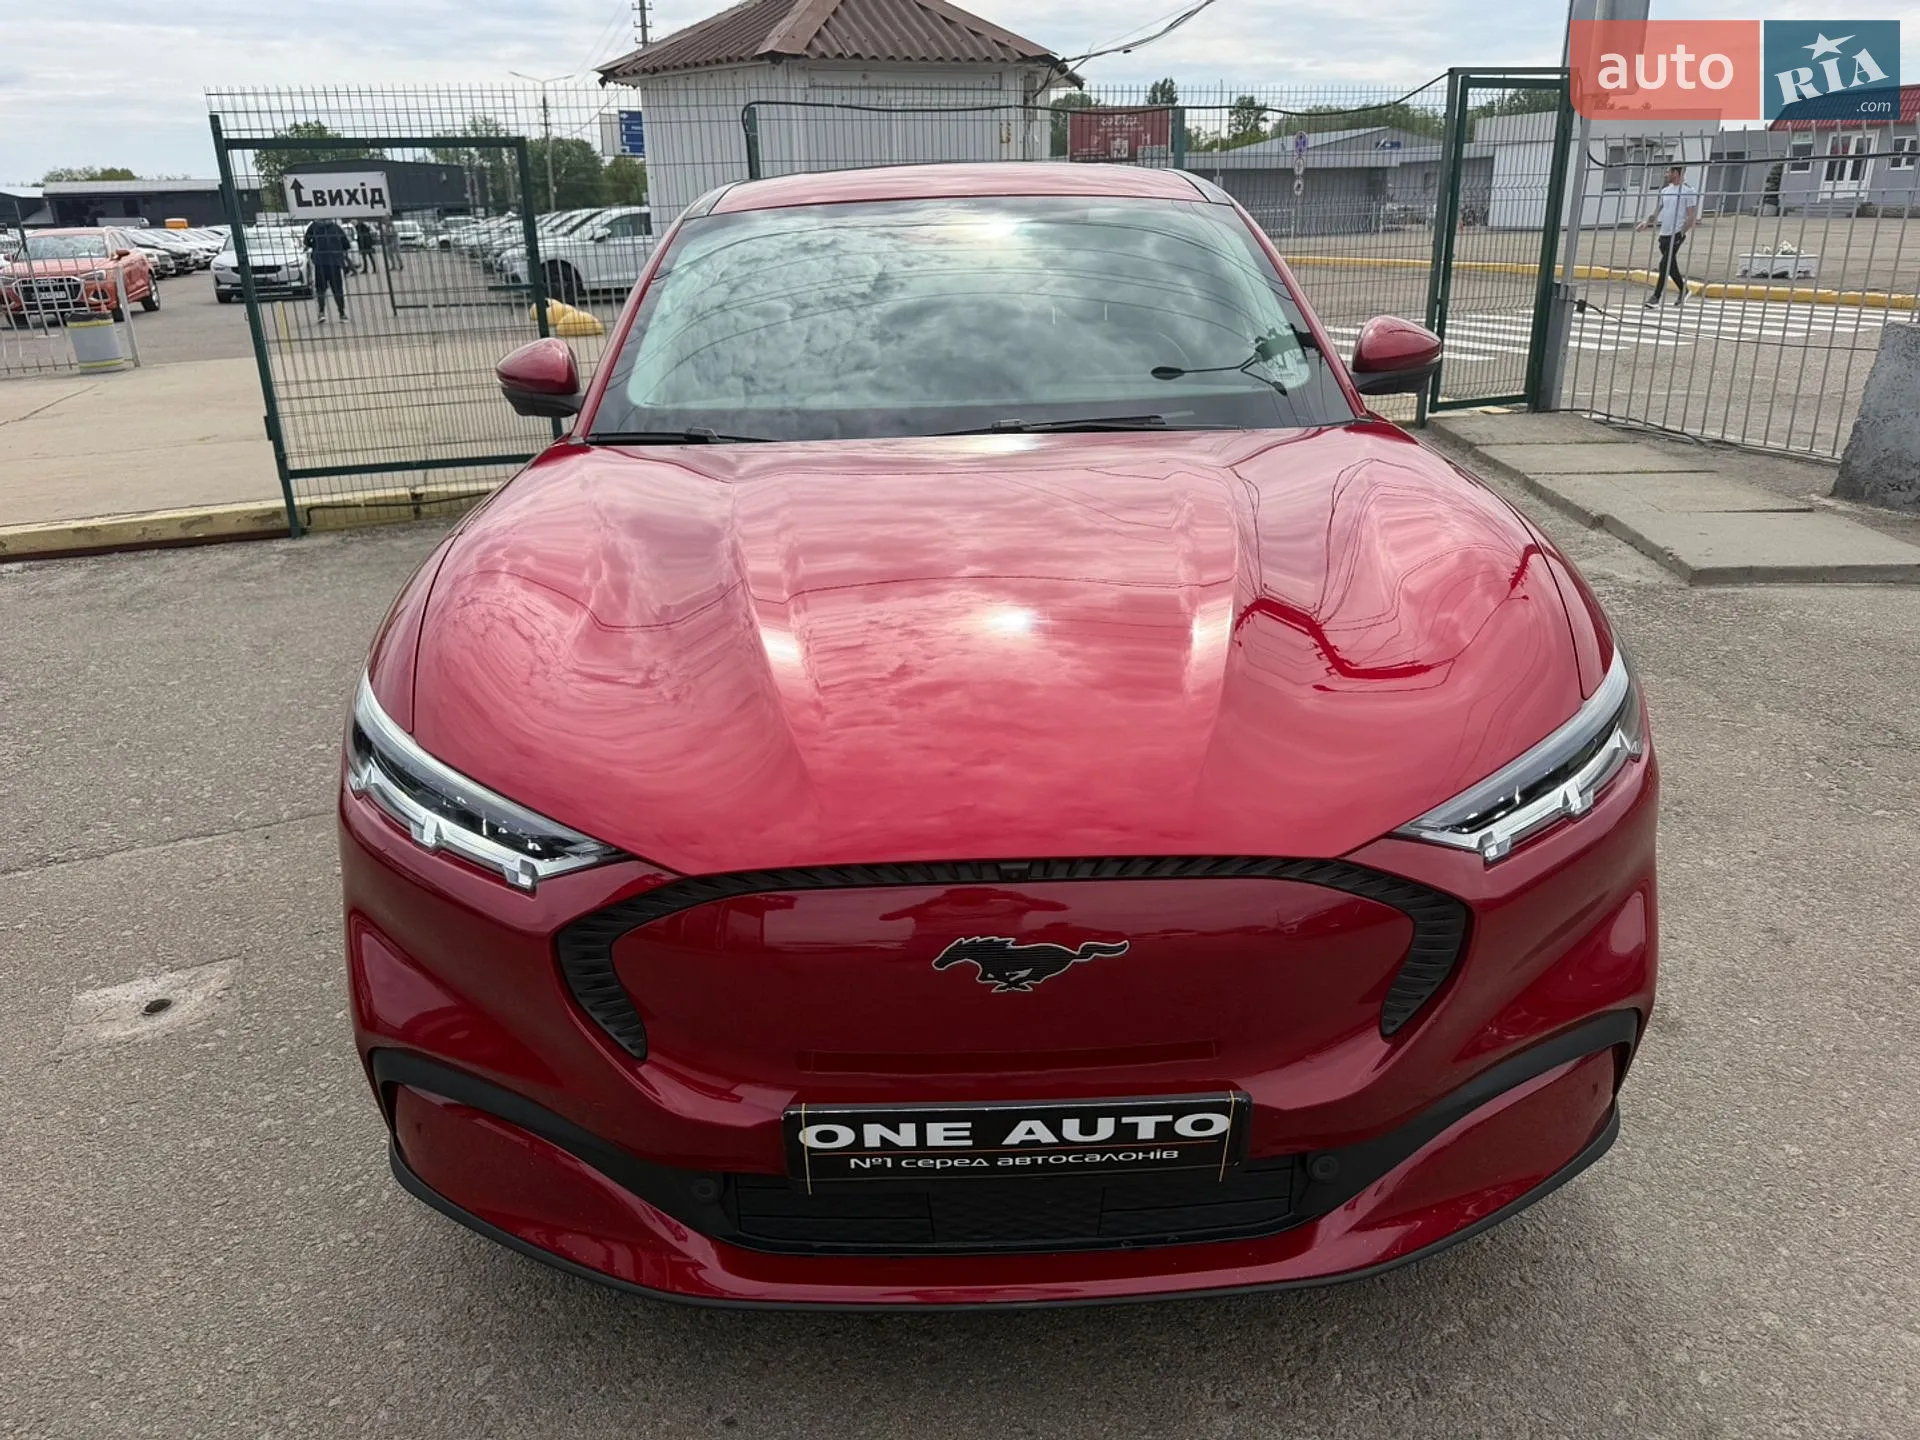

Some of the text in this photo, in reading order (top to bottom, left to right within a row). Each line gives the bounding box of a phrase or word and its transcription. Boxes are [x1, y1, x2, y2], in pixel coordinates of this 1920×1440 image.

[312, 182, 387, 210] вихід
[798, 1113, 1231, 1149] ONE AUTO
[900, 1157, 991, 1170] серед
[996, 1148, 1180, 1167] автосалонів
